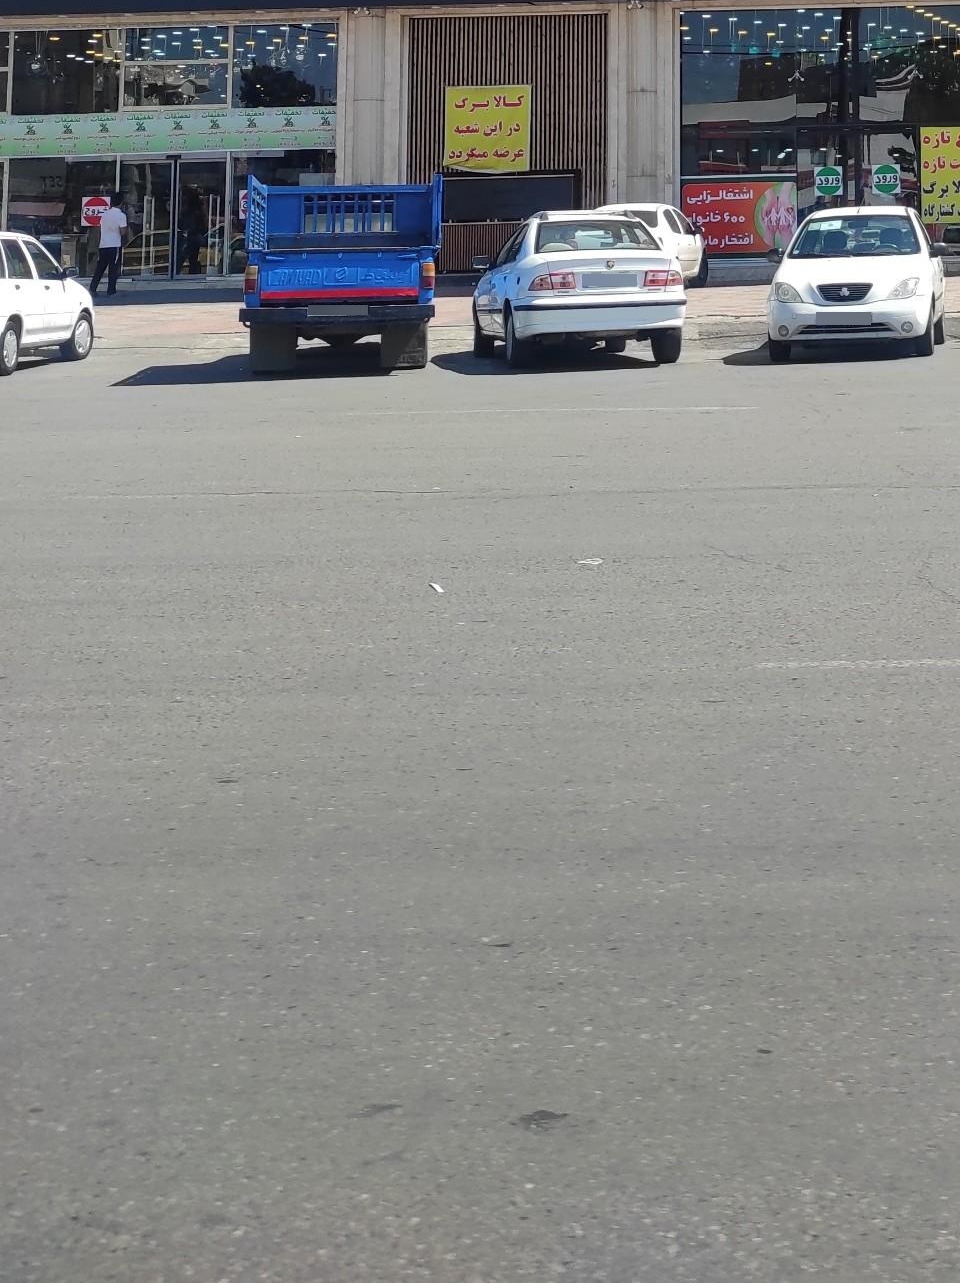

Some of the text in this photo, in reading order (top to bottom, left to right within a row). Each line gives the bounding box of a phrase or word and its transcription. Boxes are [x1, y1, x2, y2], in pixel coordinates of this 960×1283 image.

[493, 95, 524, 108] کالا
[312, 107, 336, 115] خفیفات
[454, 120, 521, 138] در این شعبه
[923, 131, 951, 149] تازه
[448, 146, 524, 162] عرضه میگردد
[923, 157, 946, 173] تازه
[817, 176, 840, 186] ورود
[875, 174, 898, 184] ورود
[923, 181, 949, 199] برگ
[691, 210, 721, 226] خانوا
[720, 233, 754, 249] افتخار
